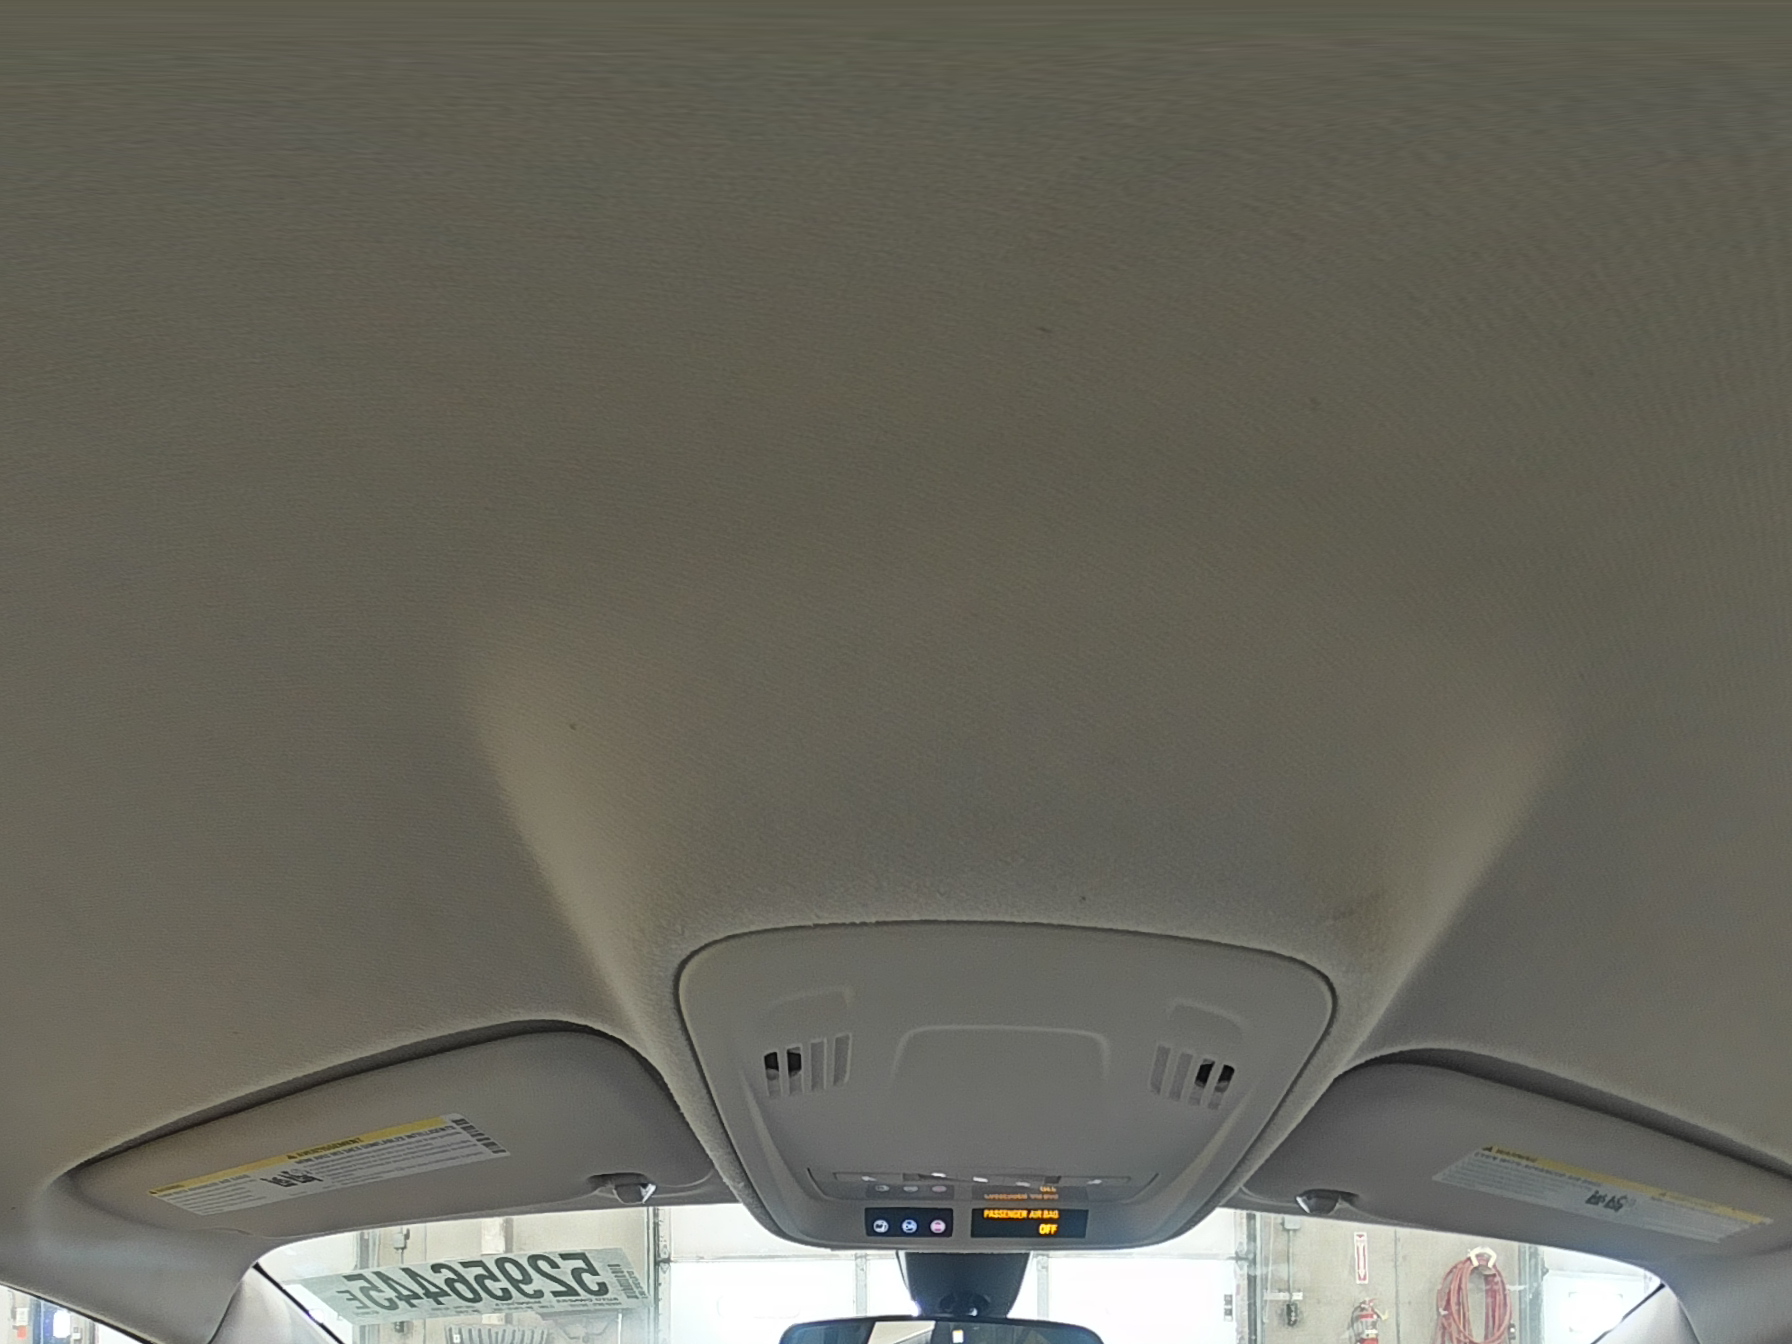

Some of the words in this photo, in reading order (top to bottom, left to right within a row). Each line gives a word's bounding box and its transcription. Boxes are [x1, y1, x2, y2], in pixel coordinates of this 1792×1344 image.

[984, 1209, 1027, 1219] PASSENGER
[1029, 1210, 1042, 1219] AIR
[1043, 1210, 1058, 1219] BAG
[1039, 1224, 1058, 1235] OFF
